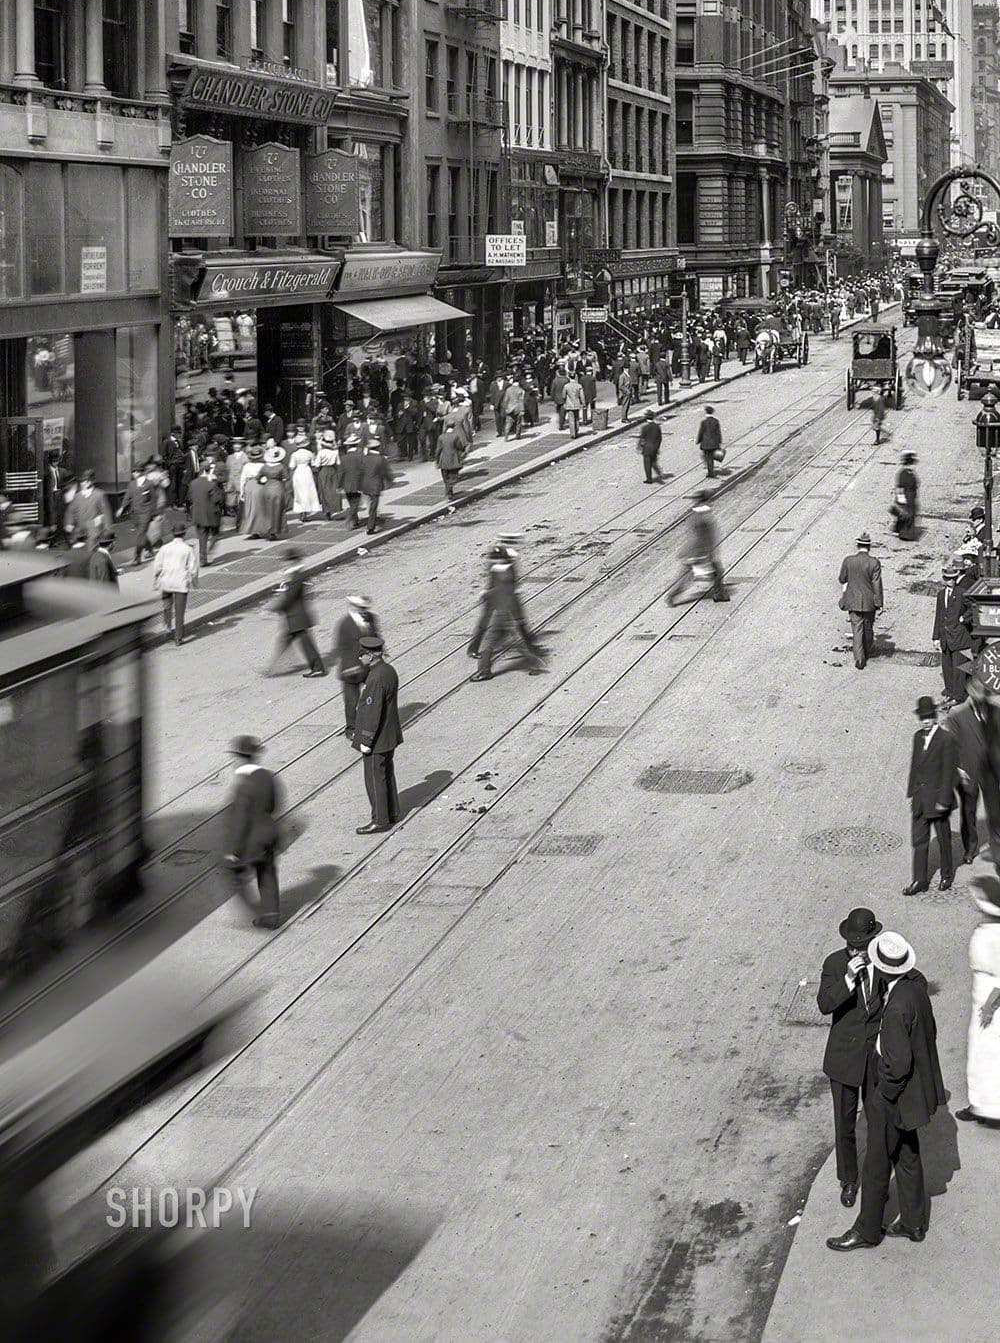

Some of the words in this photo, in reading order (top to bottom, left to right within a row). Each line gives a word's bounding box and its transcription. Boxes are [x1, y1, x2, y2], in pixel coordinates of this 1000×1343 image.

[190, 145, 208, 159] 177
[172, 160, 226, 176] CHANDLER
[181, 176, 218, 187] STONE
[316, 184, 348, 194] STONE
[181, 209, 217, 217] CLOTHES
[211, 272, 259, 293] Crouch
[259, 271, 271, 289] &
